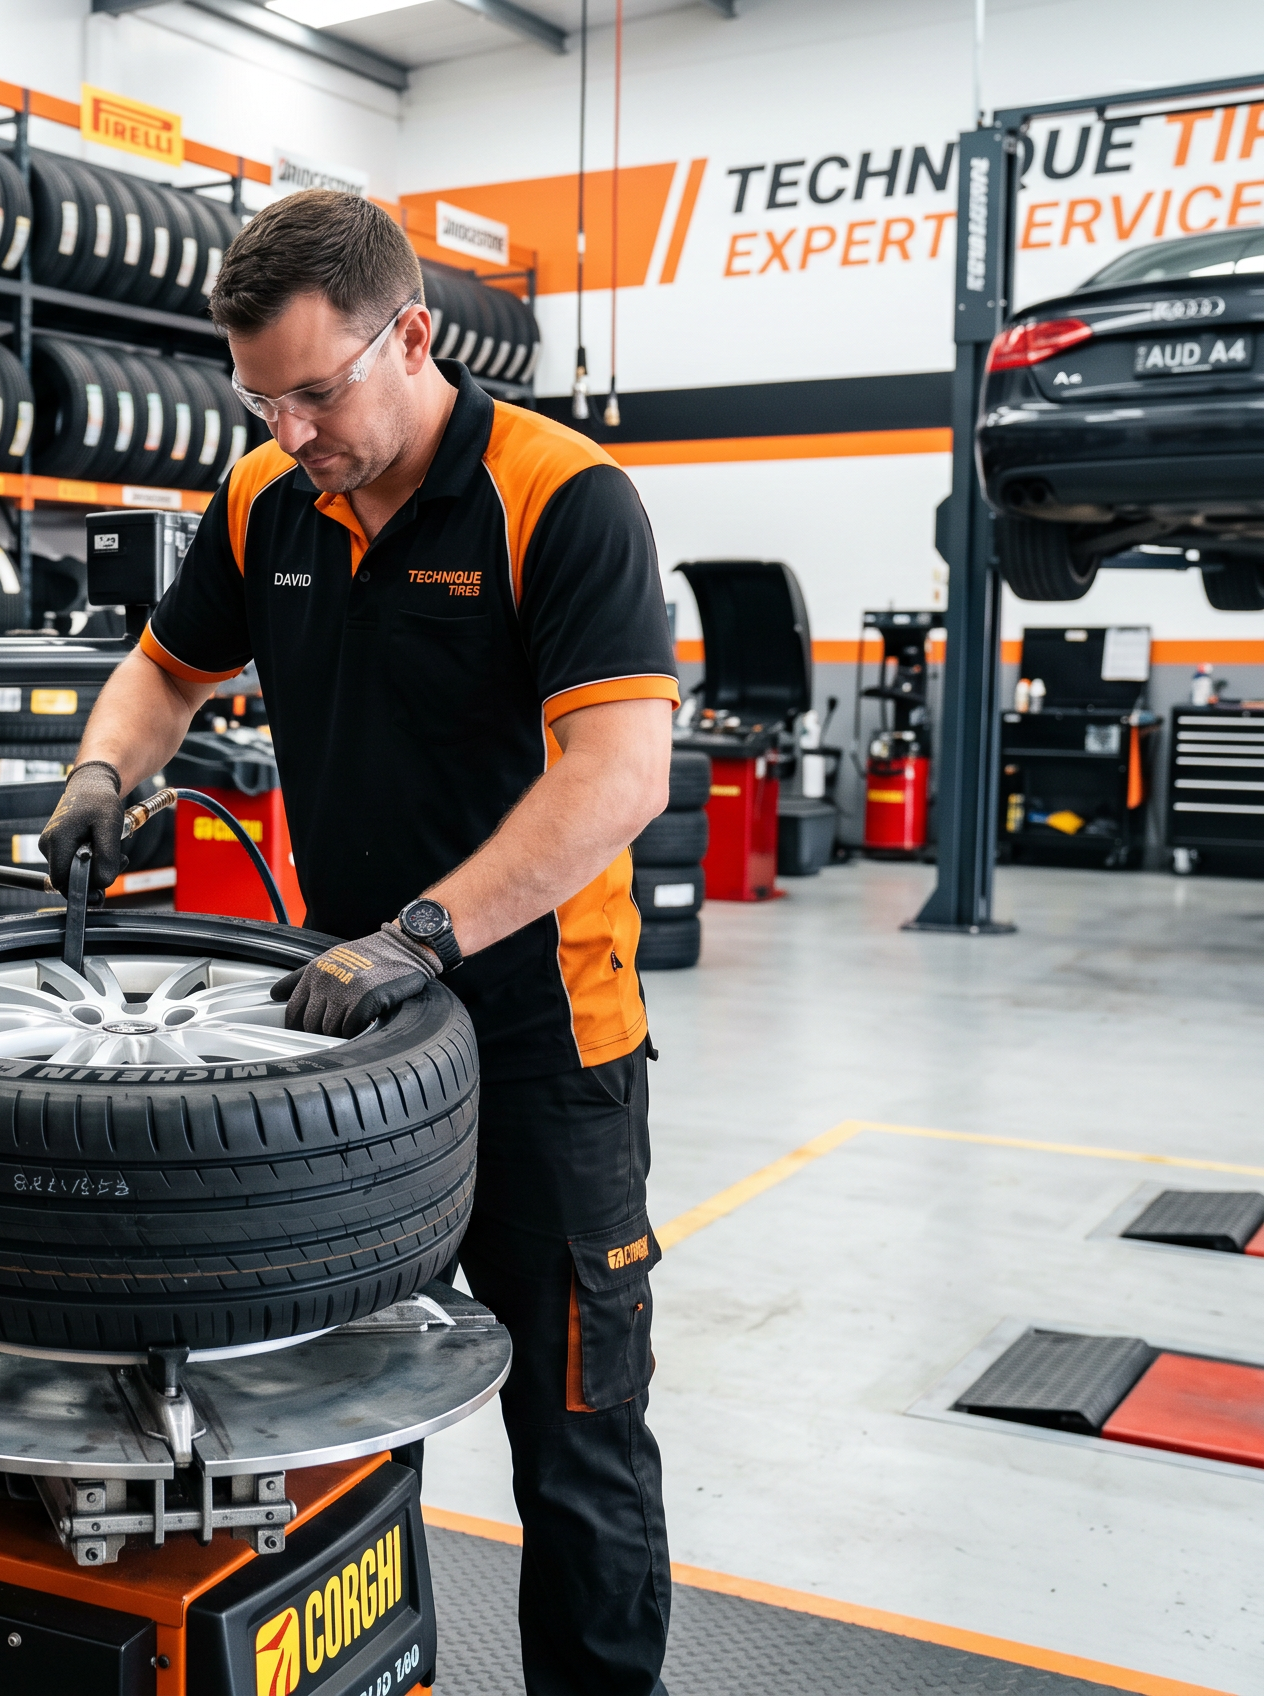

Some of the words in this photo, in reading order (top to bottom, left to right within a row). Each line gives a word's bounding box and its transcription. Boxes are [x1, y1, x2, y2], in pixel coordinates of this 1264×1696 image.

[91, 97, 173, 156] PIRELLI
[723, 211, 958, 278] EXPERT
[1145, 342, 1202, 369] AUD
[1208, 338, 1246, 363] A4
[274, 573, 312, 587] DAVID
[408, 570, 482, 584] TECHNIQUE
[448, 585, 480, 596] TIRES
[37, 1065, 268, 1082] MICHELIN
[305, 1524, 402, 1674] CORGHI
